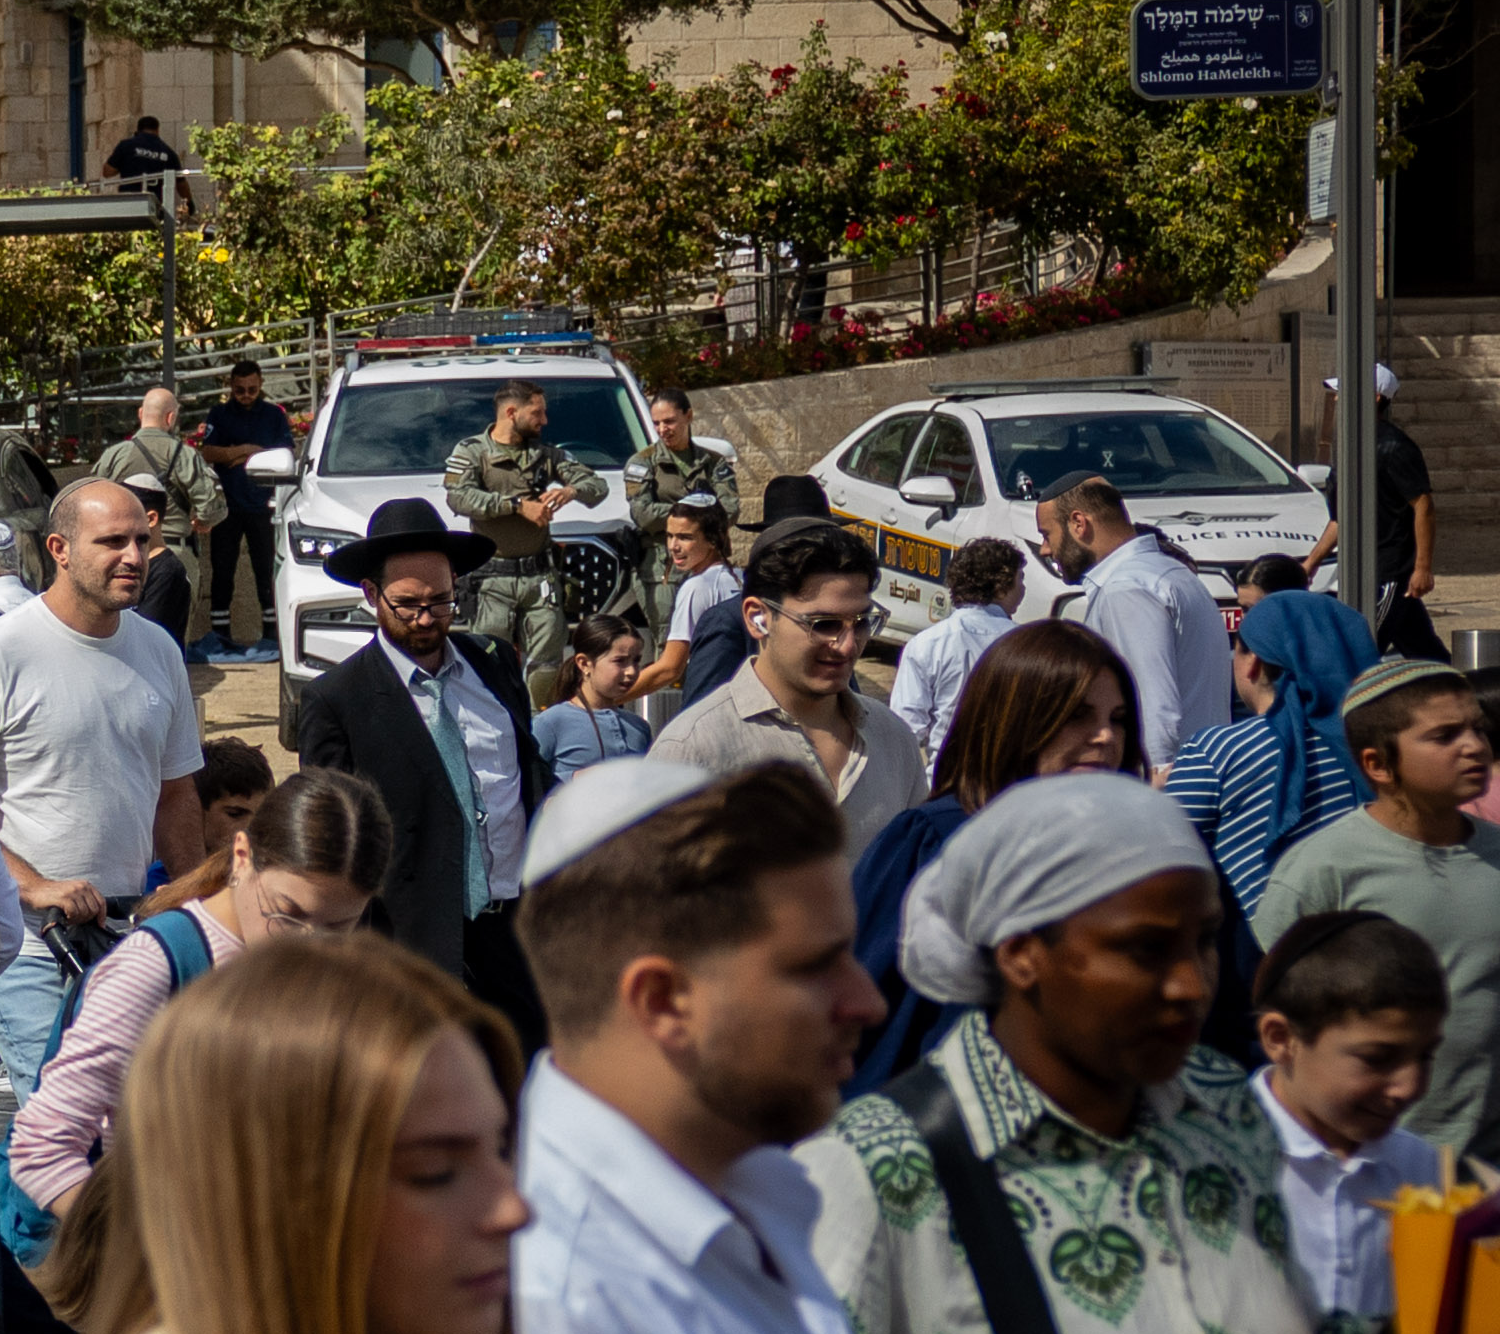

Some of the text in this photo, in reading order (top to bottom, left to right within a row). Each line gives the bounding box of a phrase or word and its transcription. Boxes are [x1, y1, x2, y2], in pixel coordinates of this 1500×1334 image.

[1204, 47, 1243, 65] شلومو
[1140, 69, 1194, 83] Shlomo
[1197, 66, 1271, 81] HaMelekh
[1168, 531, 1227, 544] LICE
[1236, 530, 1317, 542] משטרה
[885, 535, 940, 577] משטרת
